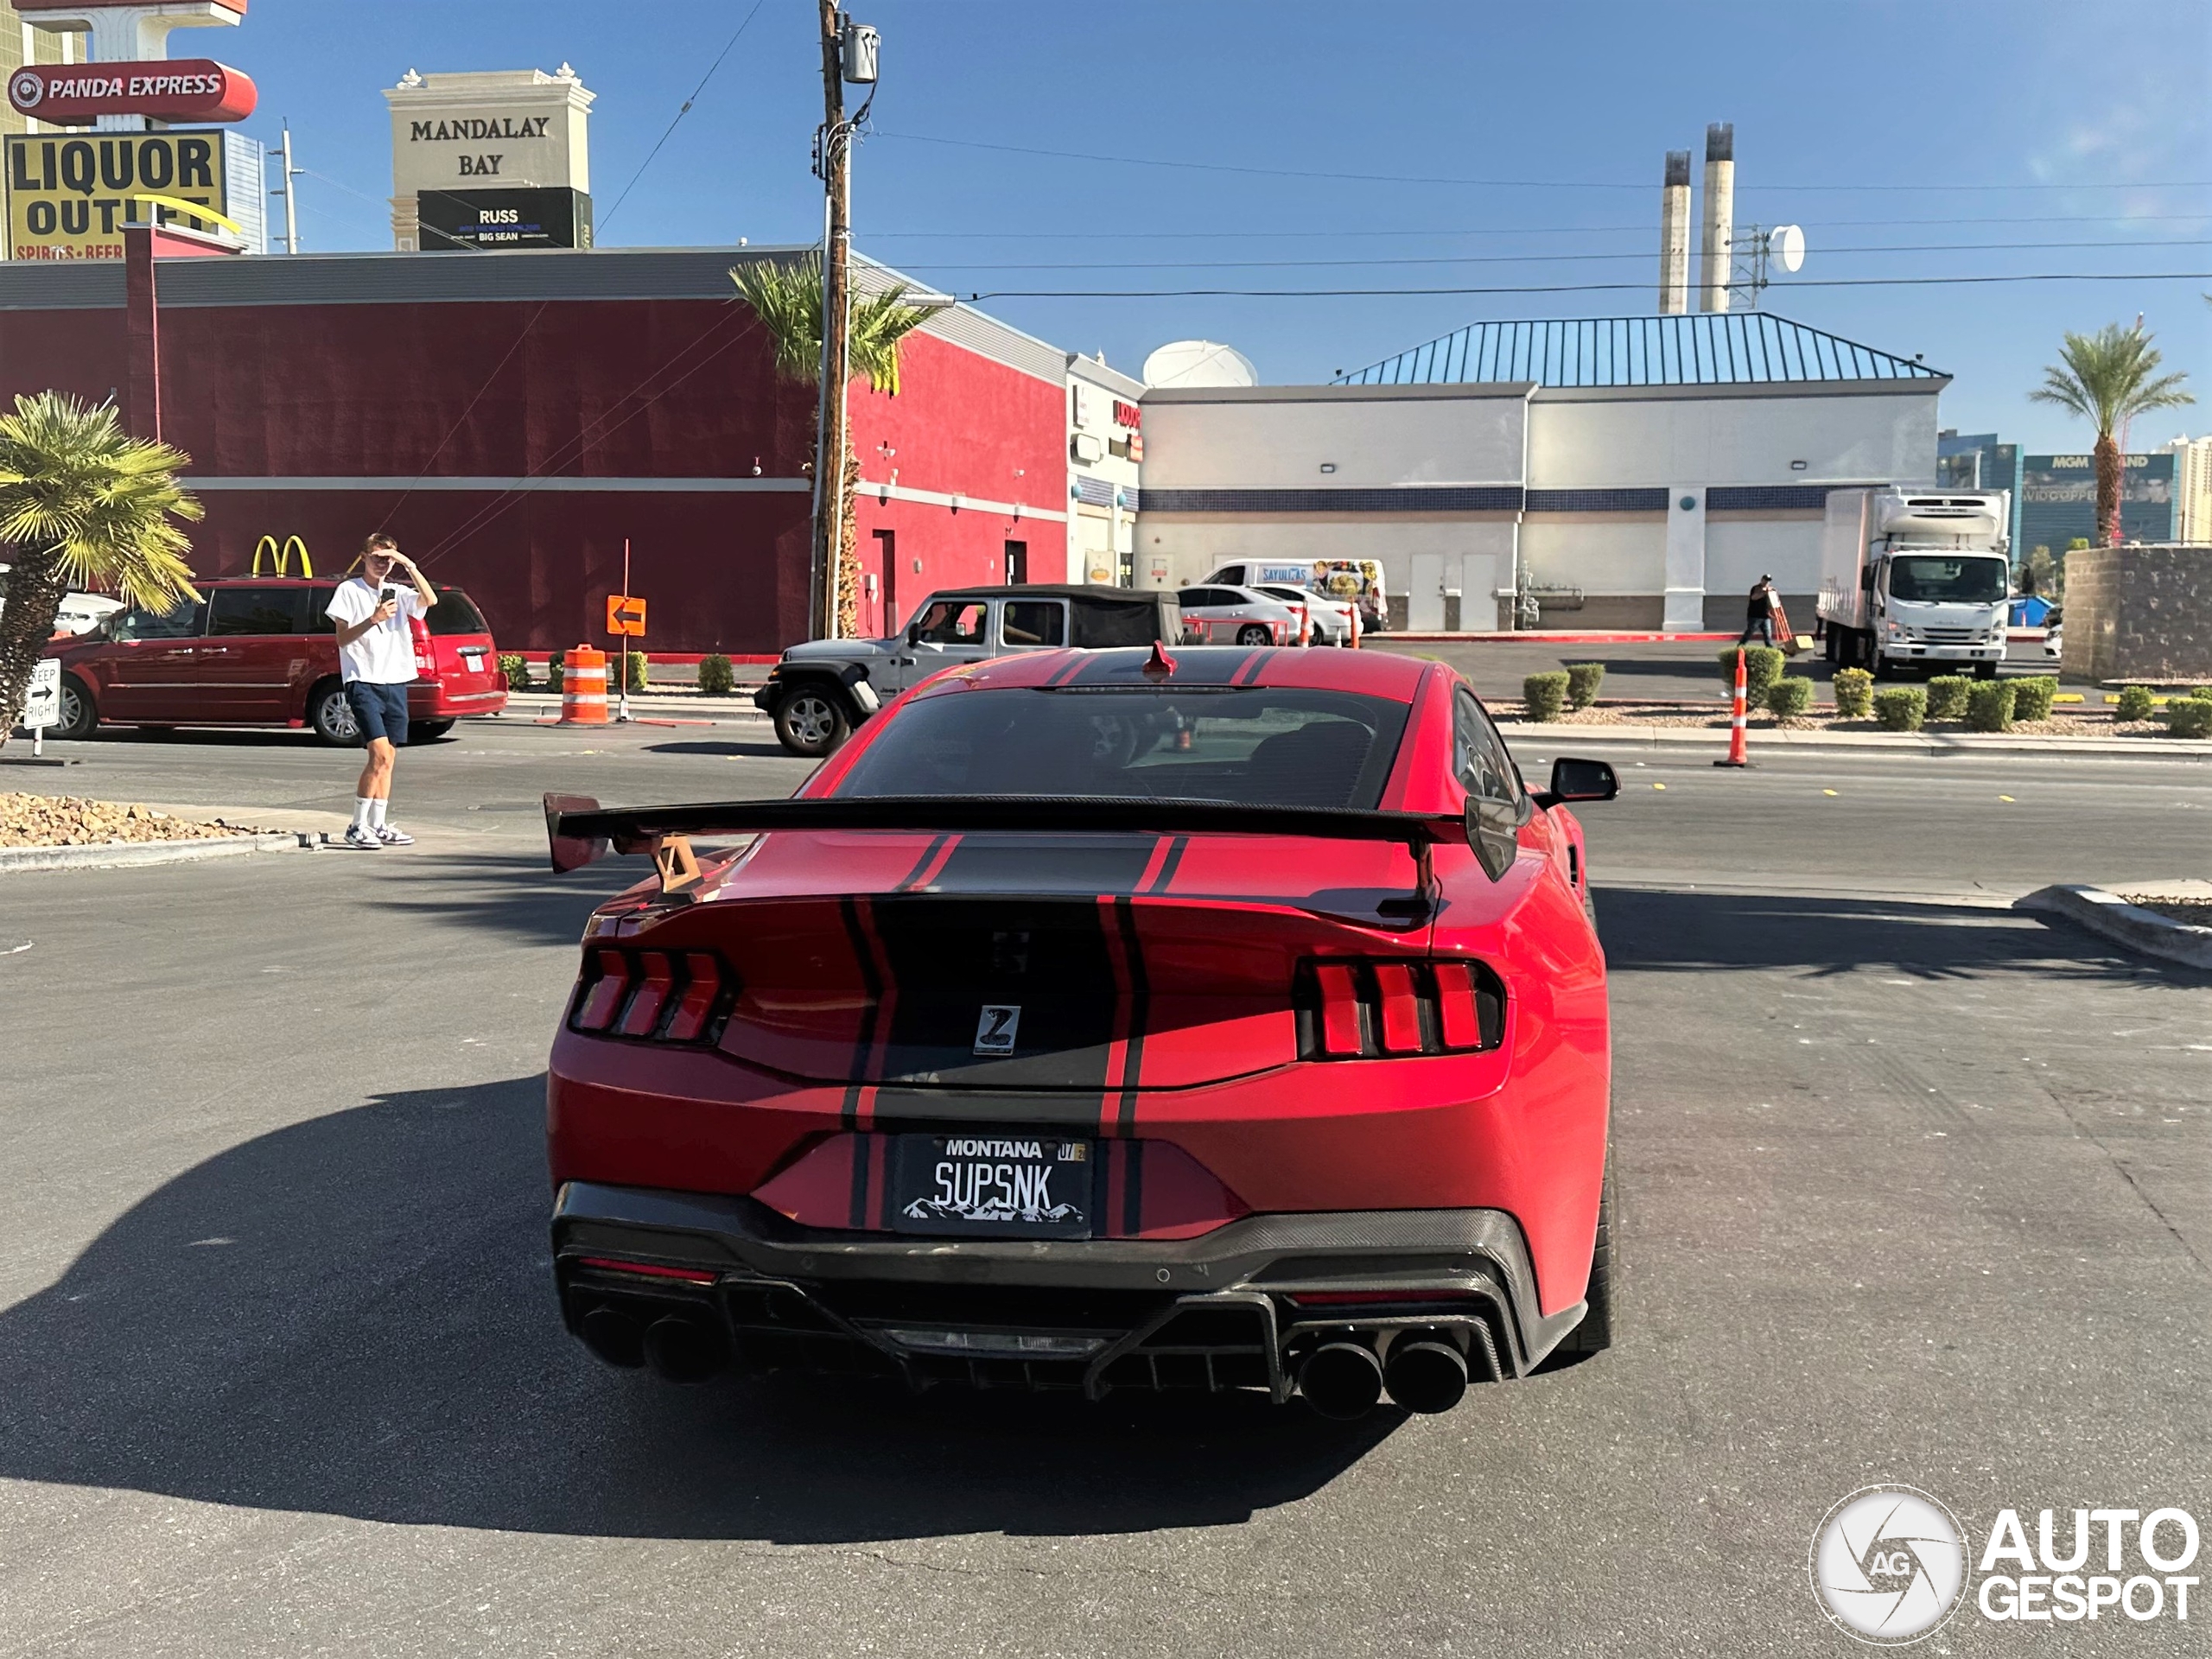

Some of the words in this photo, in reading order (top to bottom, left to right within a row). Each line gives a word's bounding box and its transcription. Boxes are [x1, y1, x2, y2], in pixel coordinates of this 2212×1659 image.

[48, 79, 123, 99] PANDA
[128, 73, 221, 97] EXPRESS
[410, 117, 550, 142] MANDALAY
[11, 138, 213, 197] LIQUOR
[458, 155, 504, 175] BAY
[480, 209, 518, 224] RUSS
[479, 232, 493, 242] BIG
[495, 232, 518, 241] SEAN
[2052, 456, 2089, 468] MGM
[29, 703, 57, 718] RIGHT
[946, 1139, 1043, 1159] MONTANA
[934, 1161, 1052, 1210] SUPSNK
